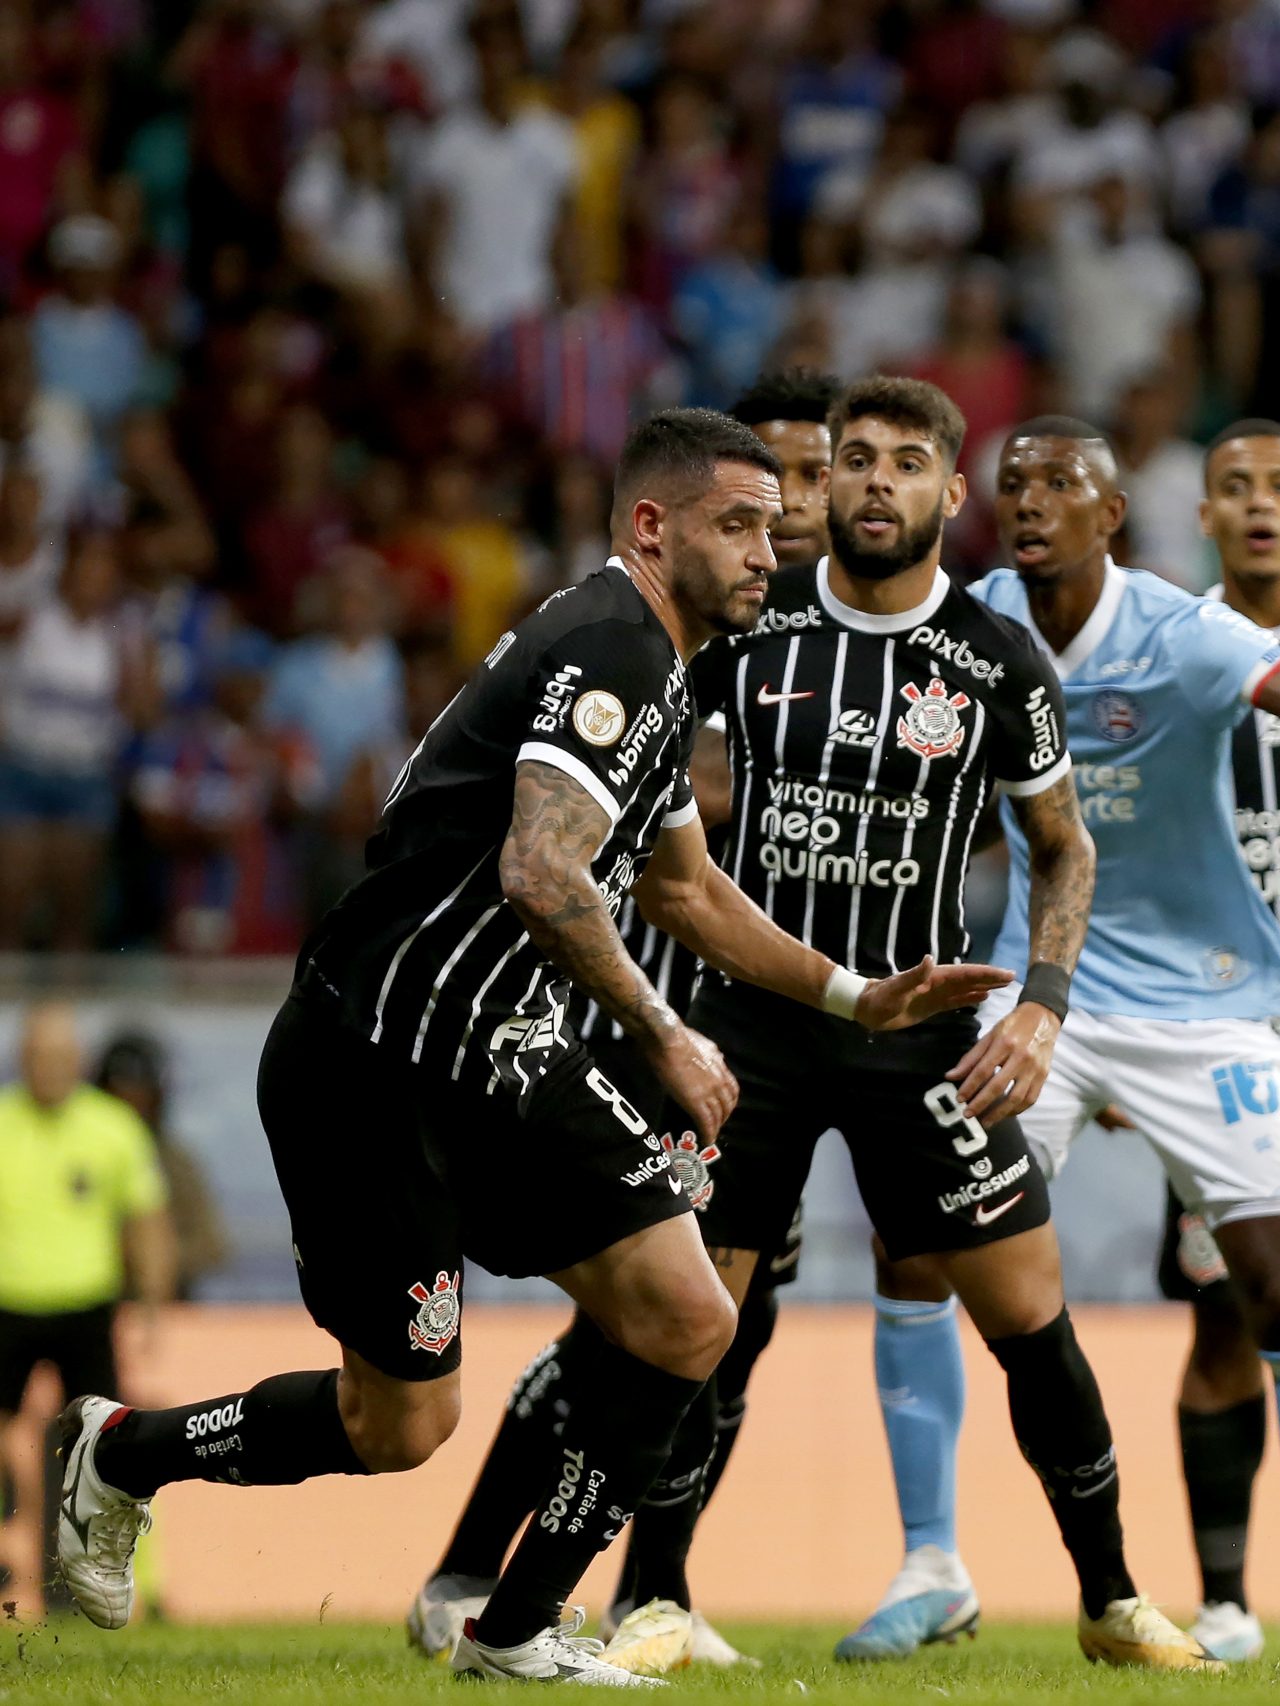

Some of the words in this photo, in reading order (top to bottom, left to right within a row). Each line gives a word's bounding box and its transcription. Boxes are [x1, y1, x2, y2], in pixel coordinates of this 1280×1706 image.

[728, 604, 822, 647] xbet
[906, 626, 1005, 688] pixbet
[616, 703, 663, 771] bmg
[621, 704, 647, 747] CORINTHIANS
[827, 730, 879, 748] ALE
[1030, 702, 1056, 770] bmg
[767, 777, 930, 819] vitaminas
[1082, 792, 1135, 822] rte
[760, 805, 840, 846] neo
[585, 1066, 648, 1135] 8
[923, 1081, 988, 1157] 9
[937, 1154, 1031, 1213] UniCesumar
[185, 1397, 244, 1440] TODOS
[540, 1448, 584, 1533] TODOS
[577, 1469, 606, 1516] Cartão
[567, 1516, 585, 1534] de
